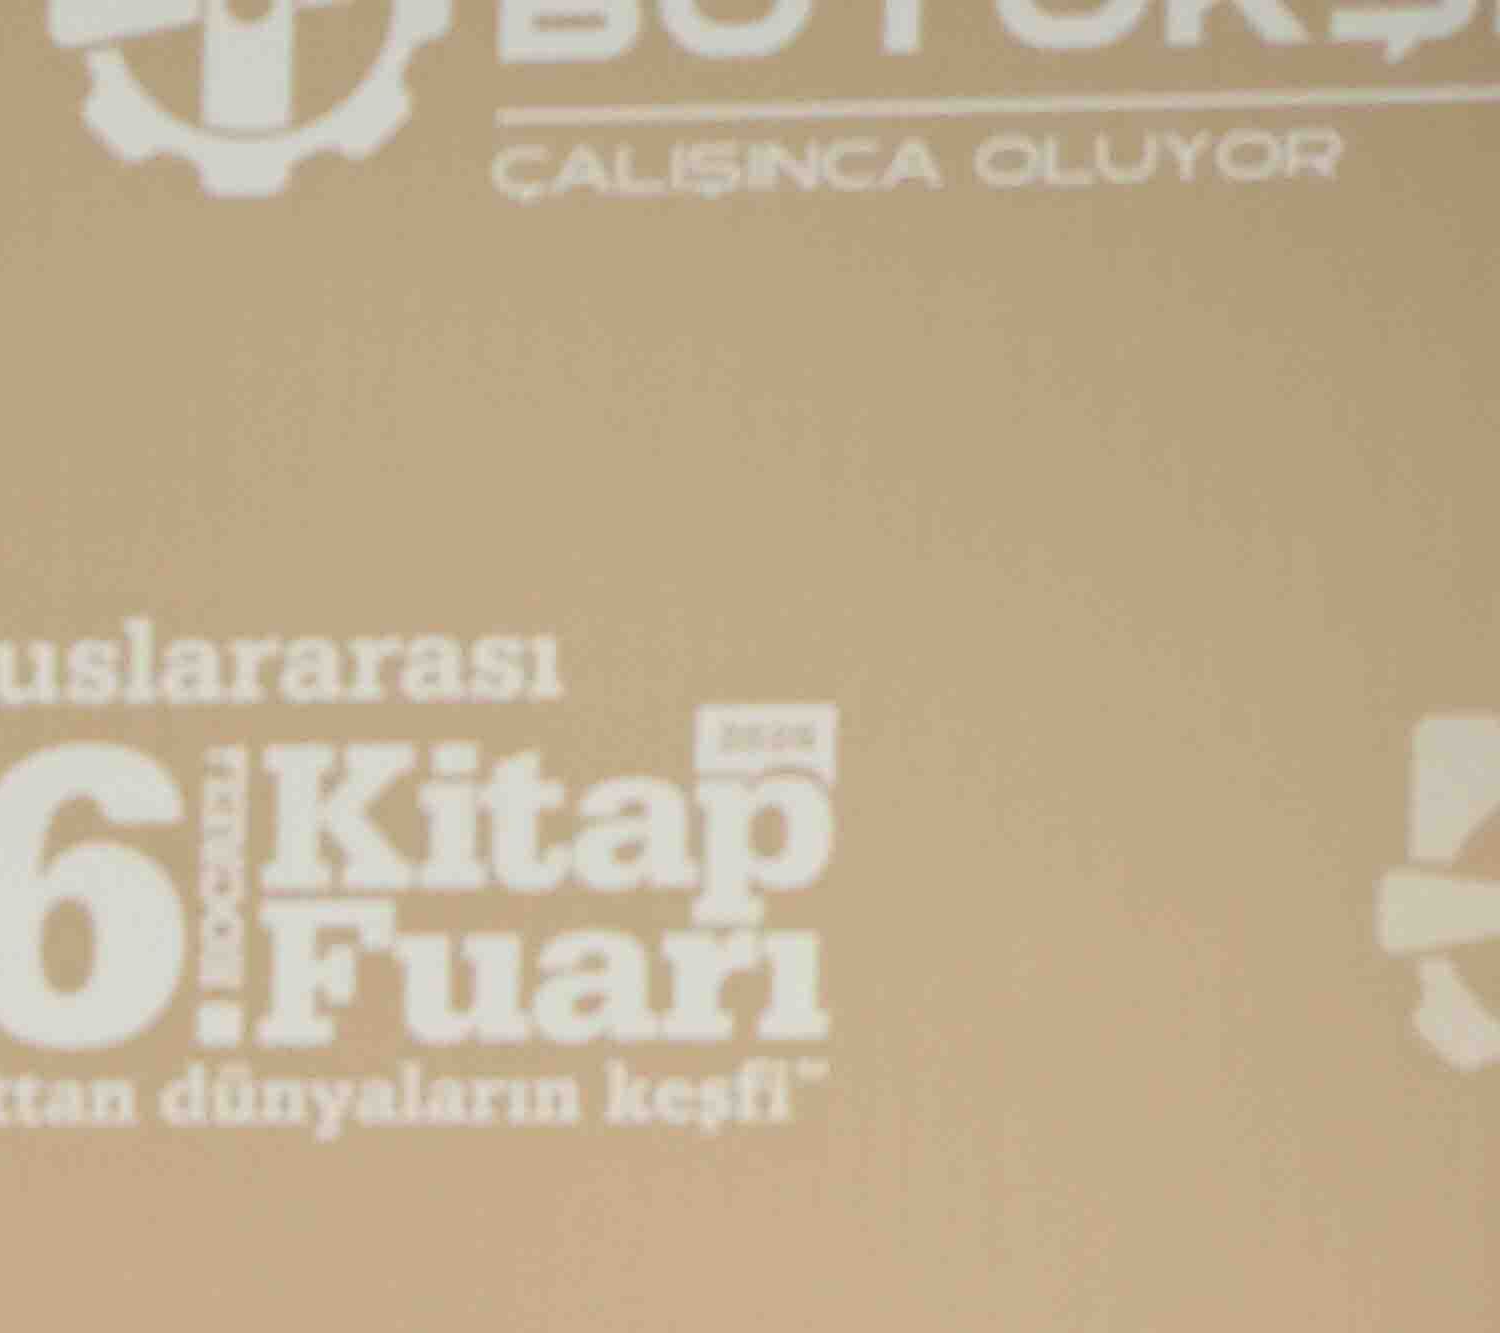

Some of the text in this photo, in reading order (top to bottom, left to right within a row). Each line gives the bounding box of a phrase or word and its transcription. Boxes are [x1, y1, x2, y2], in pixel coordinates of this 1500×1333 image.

[491, 128, 1342, 199] ÇALIŞINCA OLUYOR
[261, 743, 837, 927] Kitap
[256, 895, 829, 1045] Fuarı
